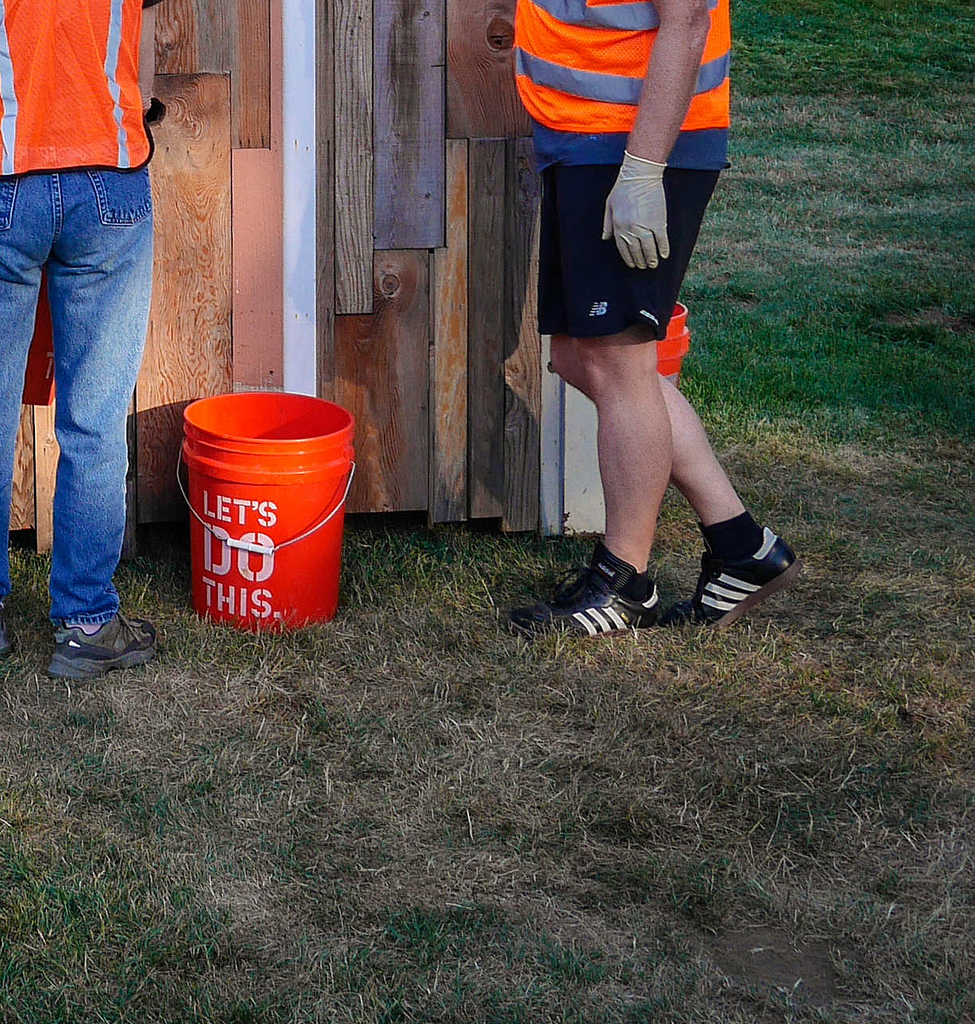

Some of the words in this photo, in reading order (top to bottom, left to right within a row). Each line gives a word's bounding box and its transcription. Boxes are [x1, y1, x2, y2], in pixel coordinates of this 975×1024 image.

[202, 490, 278, 528] LET'S
[202, 523, 276, 582] DO
[202, 576, 282, 619] THIS.
